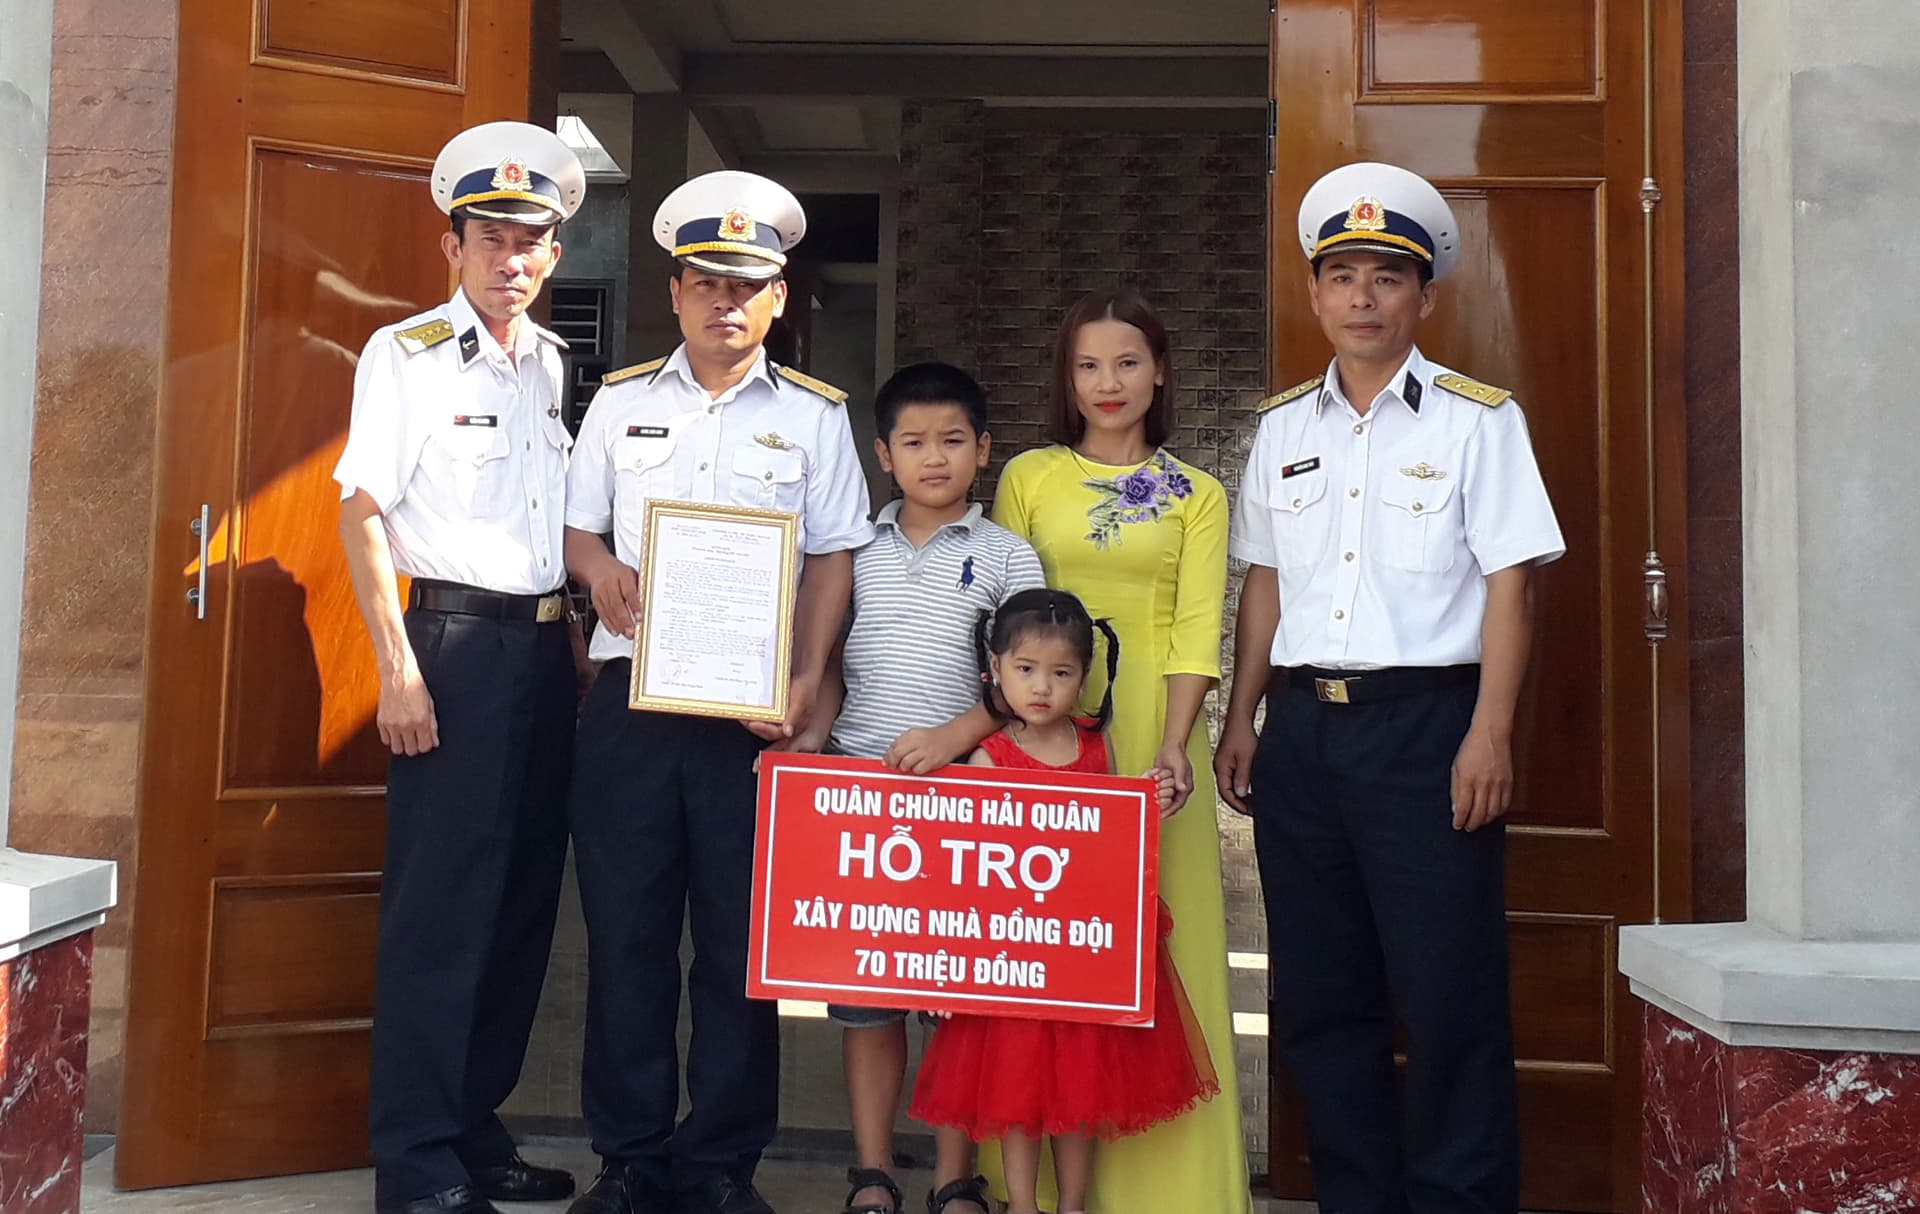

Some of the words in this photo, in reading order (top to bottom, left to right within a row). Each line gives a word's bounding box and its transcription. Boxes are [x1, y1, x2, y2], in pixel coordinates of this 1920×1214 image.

[815, 785, 881, 816] QUÂN
[889, 787, 973, 823] CHỦNG
[982, 793, 1023, 826] HẢI
[1031, 800, 1100, 832] QUÂN
[839, 825, 922, 881] HỖ
[941, 839, 1069, 902] TRỢ
[793, 896, 843, 928] XÂY
[850, 904, 920, 937] DỰNG
[929, 907, 981, 939] NHÀ
[989, 908, 1060, 944] ĐỒNG
[1069, 917, 1112, 953] ĐỘI
[855, 949, 886, 977] 70
[894, 950, 966, 987] TRIỆU
[974, 951, 1045, 988] ĐỒNG
